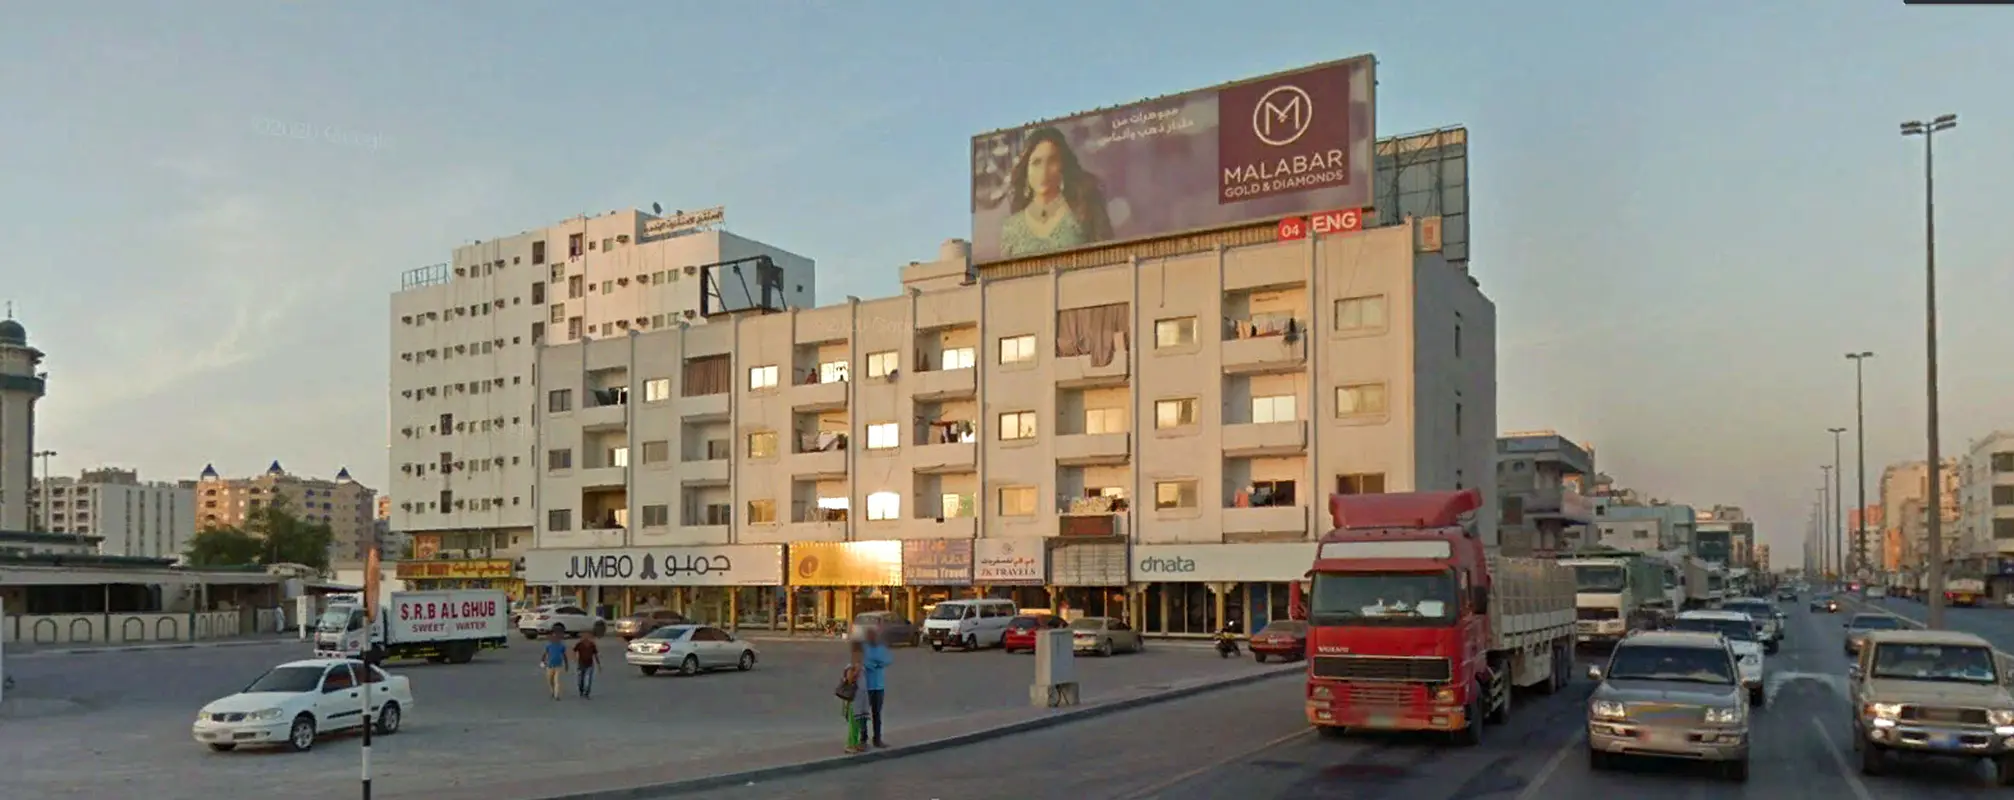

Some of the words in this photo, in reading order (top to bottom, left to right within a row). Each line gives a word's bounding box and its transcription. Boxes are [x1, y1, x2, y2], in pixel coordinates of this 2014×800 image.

[1224, 149, 1343, 186] MALABAR
[1224, 185, 1261, 198] GOLD
[1262, 181, 1271, 192] &
[1272, 169, 1344, 191] DIAMONDS
[1281, 223, 1300, 238] 04
[1312, 211, 1358, 233] ENG
[565, 554, 634, 579] JUMBO
[664, 554, 732, 577] جمبو
[995, 567, 1037, 576] TRAVELS
[1139, 555, 1196, 573] dnata
[462, 600, 496, 617] GHUB
[412, 622, 446, 633] SWEET
[456, 621, 487, 631] WATER
